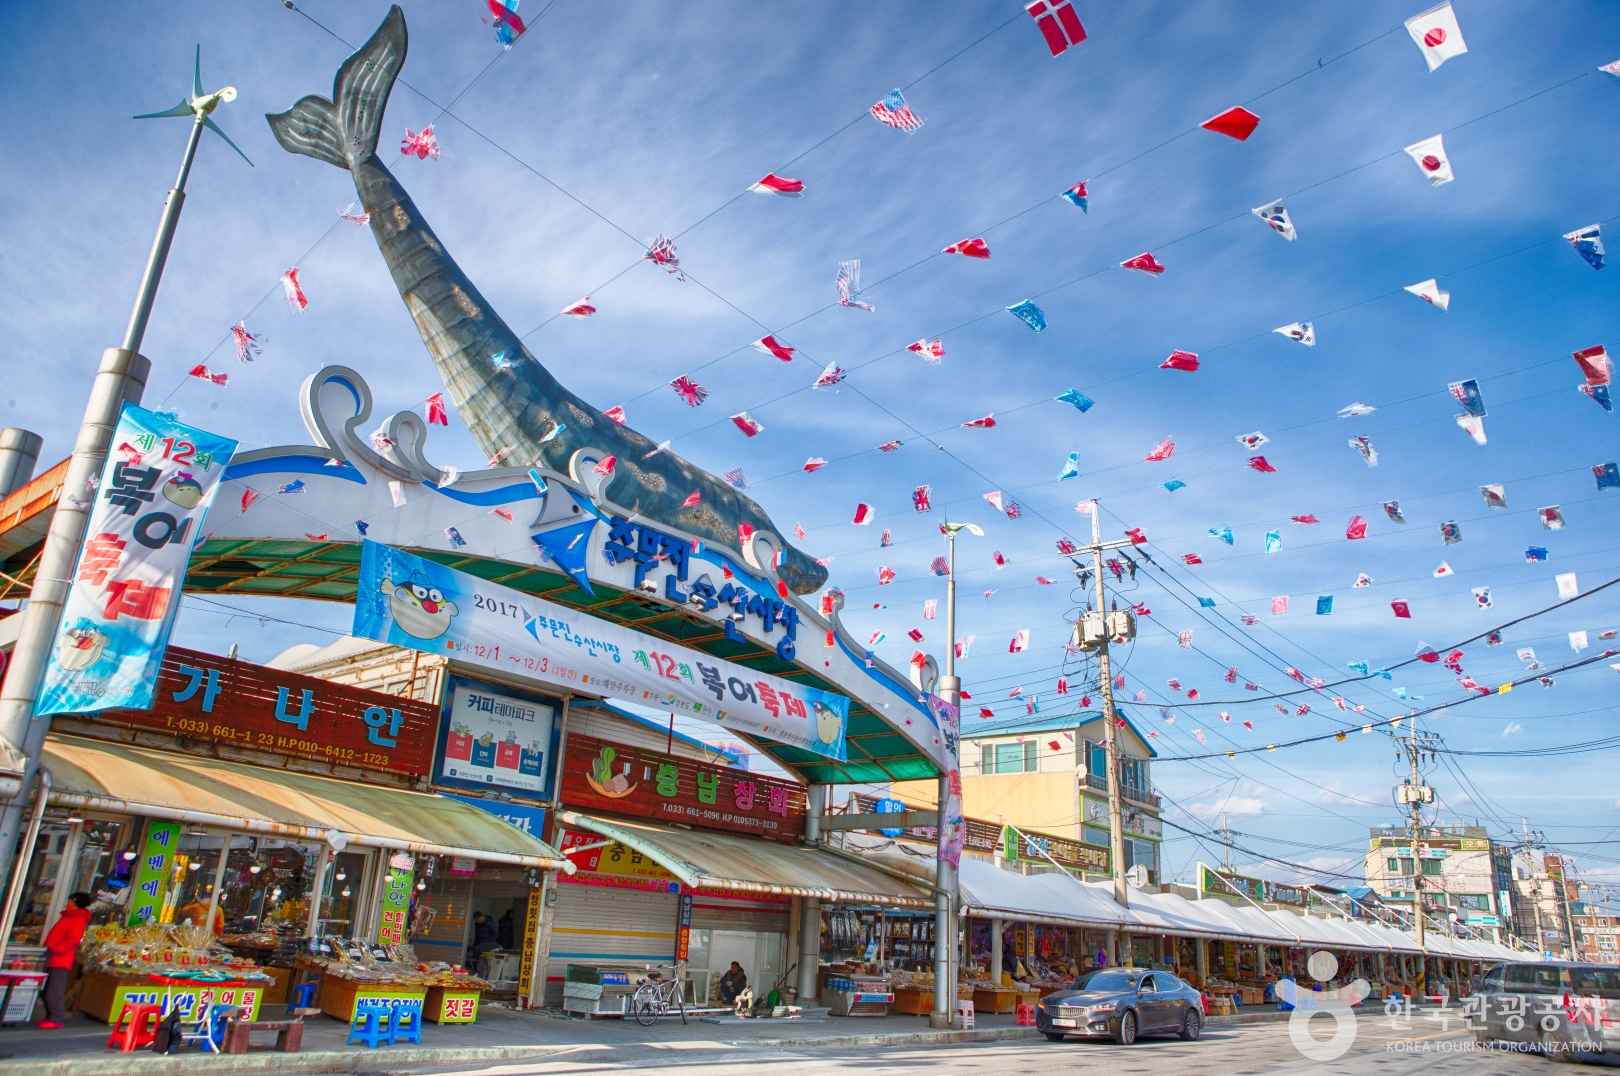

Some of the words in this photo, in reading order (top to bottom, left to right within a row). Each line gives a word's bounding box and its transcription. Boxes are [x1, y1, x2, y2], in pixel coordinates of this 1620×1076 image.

[473, 593, 519, 619] 2017
[172, 664, 405, 749] 가나안
[445, 998, 475, 1018] 젓갈
